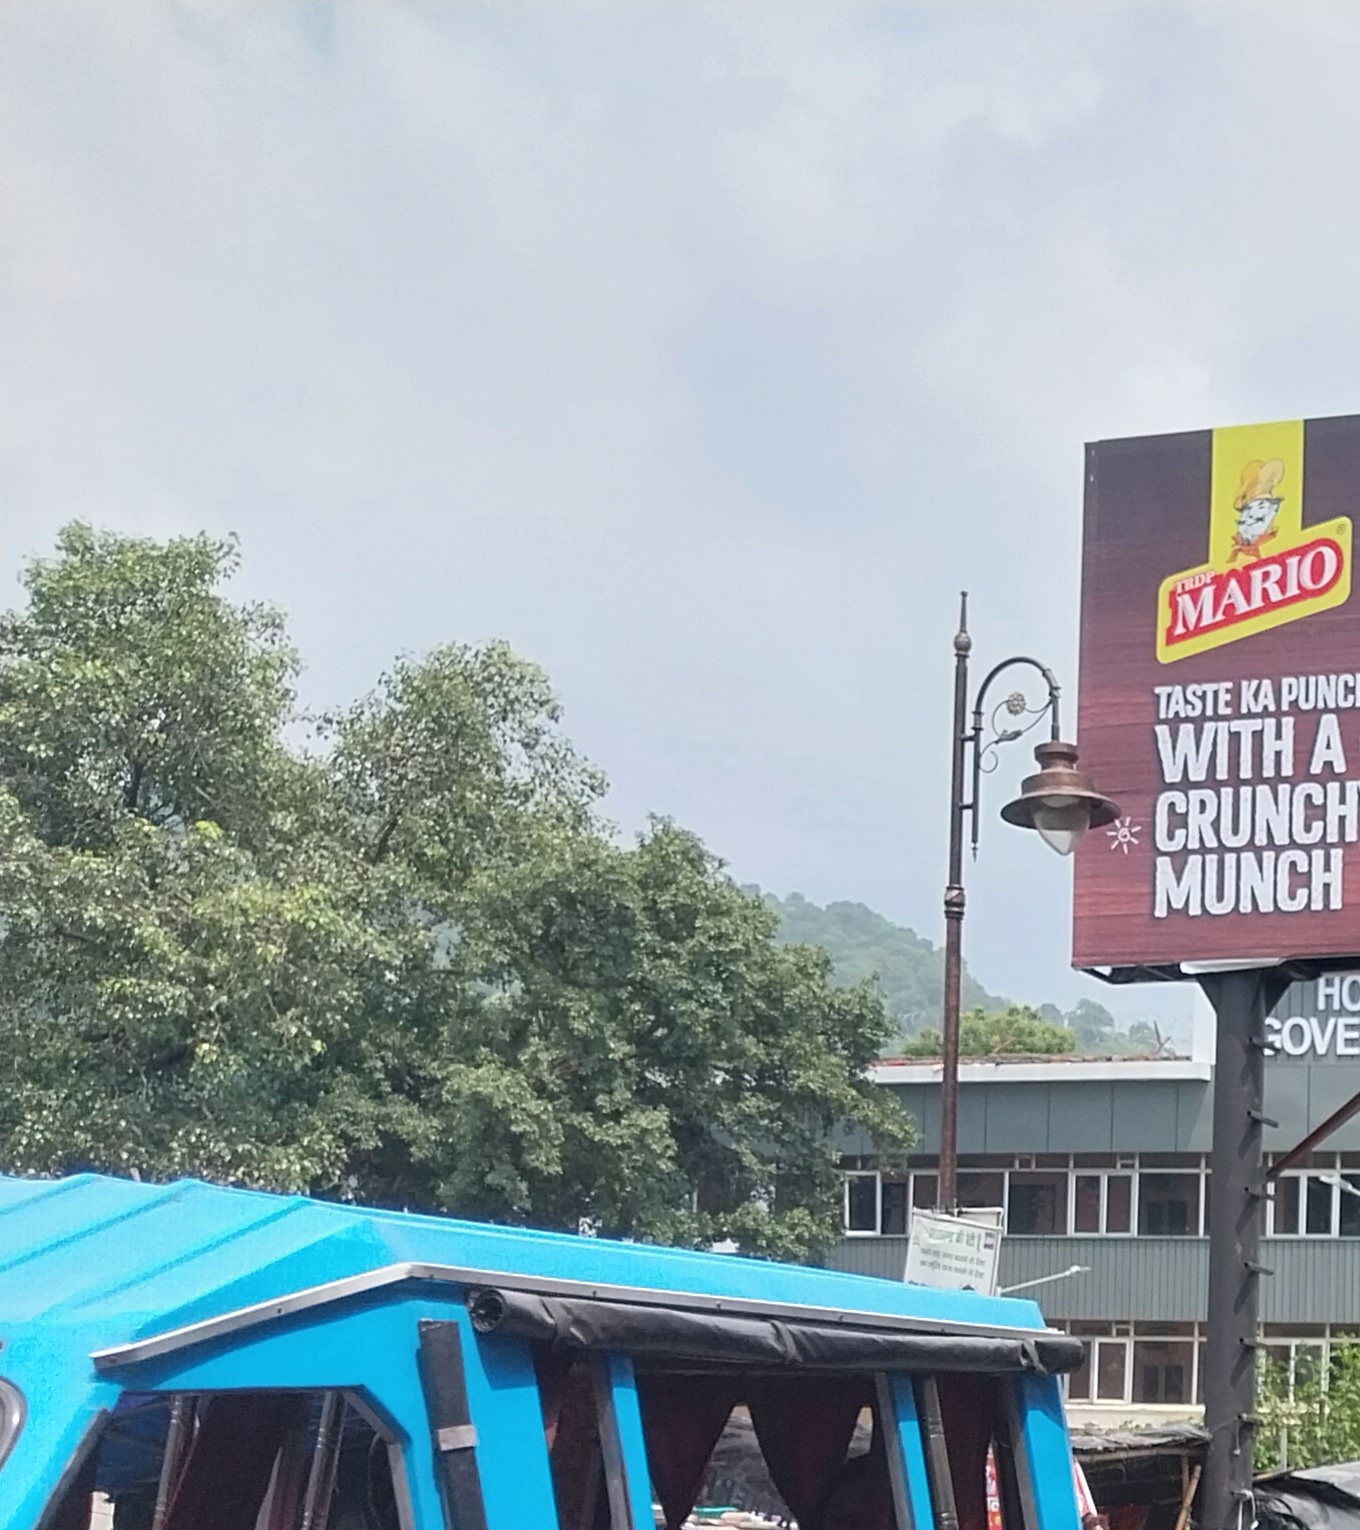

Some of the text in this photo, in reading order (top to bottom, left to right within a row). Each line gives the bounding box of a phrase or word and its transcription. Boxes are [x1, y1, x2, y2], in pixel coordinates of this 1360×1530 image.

[1173, 546, 1338, 636] MARIO
[1154, 678, 1233, 719] TASTE
[1240, 676, 1277, 713] KA
[1155, 714, 1348, 783] WITH A
[1153, 847, 1344, 918] MUNCH
